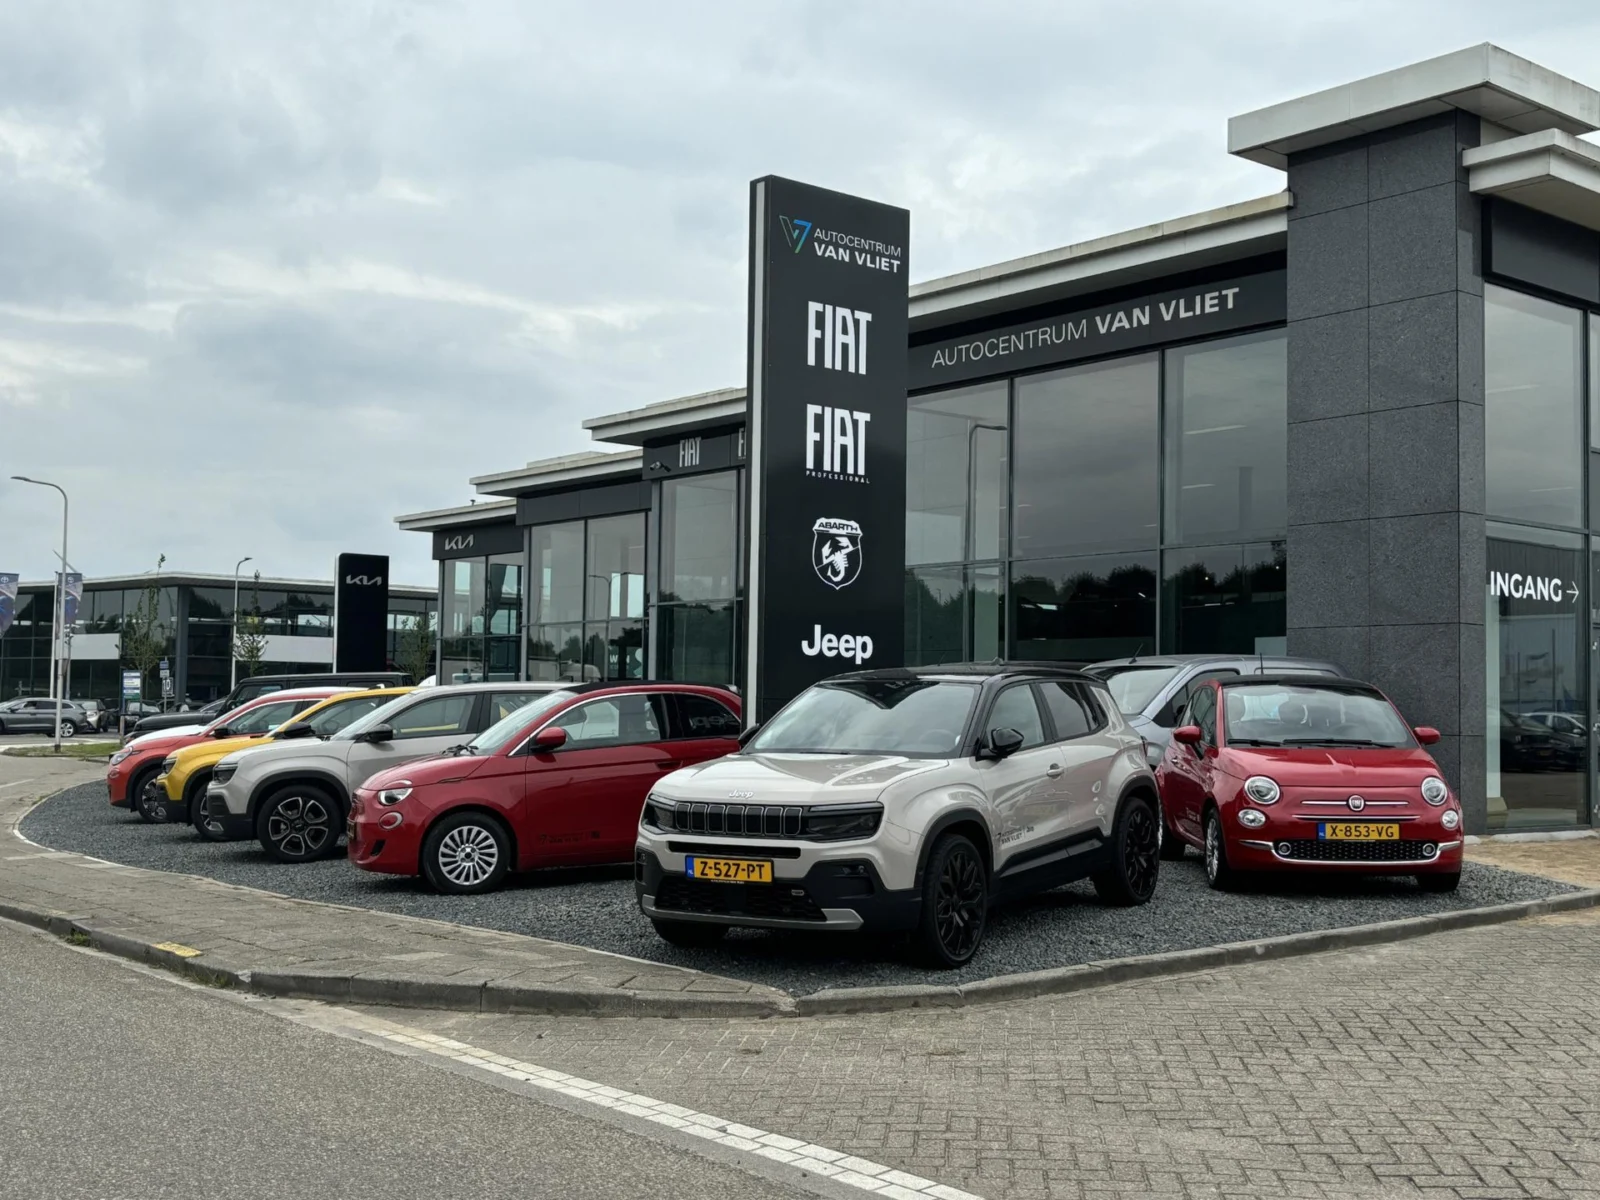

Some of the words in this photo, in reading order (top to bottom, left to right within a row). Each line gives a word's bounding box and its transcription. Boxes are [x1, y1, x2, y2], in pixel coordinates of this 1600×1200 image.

[814, 228, 901, 257] AUTOCENTRUM
[814, 241, 850, 263] VAN
[855, 251, 901, 273] VLIET
[807, 300, 872, 375] FIAT
[931, 319, 1088, 368] AUTOCENTRUM
[1095, 305, 1150, 335] VAN
[1159, 287, 1240, 322] VLIET
[679, 436, 702, 468] FIAT
[806, 403, 871, 475] FIAT
[805, 470, 870, 484] PROFESSIONAL
[817, 521, 859, 532] ABARTH
[444, 534, 474, 551] KIA
[345, 574, 382, 586] KIA
[1490, 571, 1562, 602] INGANG
[801, 624, 873, 665] Jeep
[728, 789, 754, 799] Jeep
[1330, 825, 1394, 838] X-853-VG
[700, 861, 765, 879] Z-527-PT
